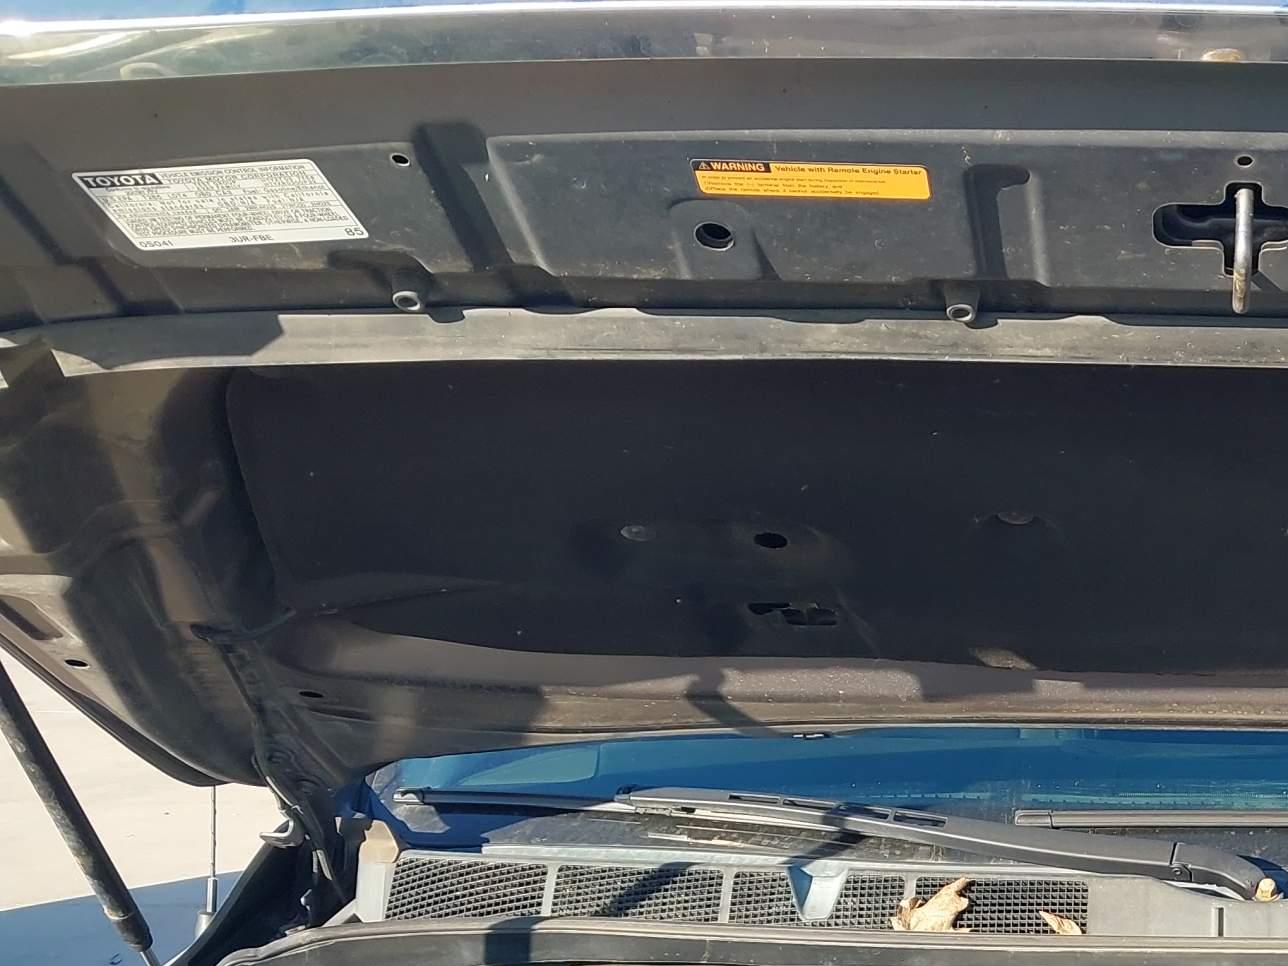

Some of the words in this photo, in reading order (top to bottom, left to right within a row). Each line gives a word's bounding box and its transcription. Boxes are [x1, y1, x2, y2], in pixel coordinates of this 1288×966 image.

[711, 162, 765, 172] WARNING
[775, 165, 805, 173] Vehicle
[82, 175, 158, 187] TOYOTA
[229, 234, 273, 243] 3UR-FBE
[344, 227, 364, 237] 85
